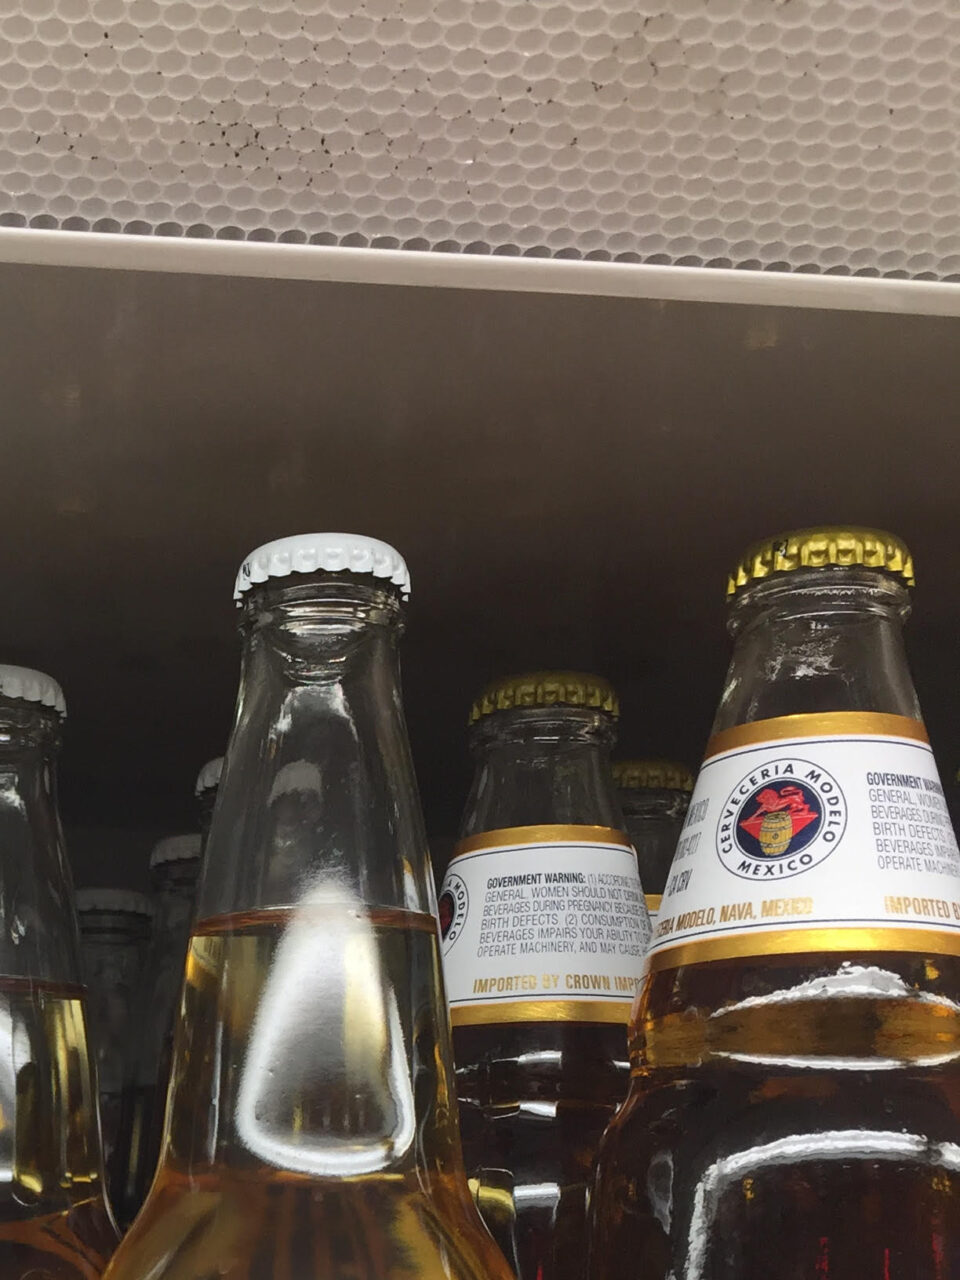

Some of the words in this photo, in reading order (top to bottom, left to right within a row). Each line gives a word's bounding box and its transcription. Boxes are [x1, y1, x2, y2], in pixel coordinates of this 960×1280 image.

[867, 772, 922, 789] GOVERNMENT
[721, 764, 794, 854] CERVECERIA
[805, 770, 842, 843] MODELO
[871, 805, 922, 823] BEVERAGES
[873, 822, 906, 837] BIRTH
[876, 839, 934, 857] BEVERAGES
[737, 854, 812, 877] MEXICO
[878, 855, 922, 872] OPERATE
[487, 873, 542, 889] GOVERNMENT
[544, 872, 586, 885] WARNING:
[531, 886, 569, 898] WOMEN
[571, 886, 606, 898] SHOULD
[607, 887, 623, 900] NOT
[483, 901, 531, 916] BEVERAGES
[533, 899, 565, 912] DURING
[567, 900, 613, 914] PREGNANCY
[676, 907, 716, 932] MODELO,
[720, 902, 757, 923] NAVA,
[761, 897, 813, 918] MEXICO
[884, 896, 950, 918] IMPORTED
[481, 916, 509, 931] BIRTH
[565, 914, 578, 927] (2)
[581, 913, 638, 929] CONSUMPTION
[480, 930, 534, 944] BEVERAGES
[537, 927, 577, 941] IMPAIRS
[579, 927, 605, 940] YOUR
[606, 928, 634, 942] ABILITY
[477, 944, 516, 958] OPERATE
[519, 942, 577, 956] MACHINERY,
[579, 942, 597, 954] AND
[600, 942, 616, 956] MAY
[473, 975, 537, 994] IMPORTED
[565, 974, 611, 990] CROWN
